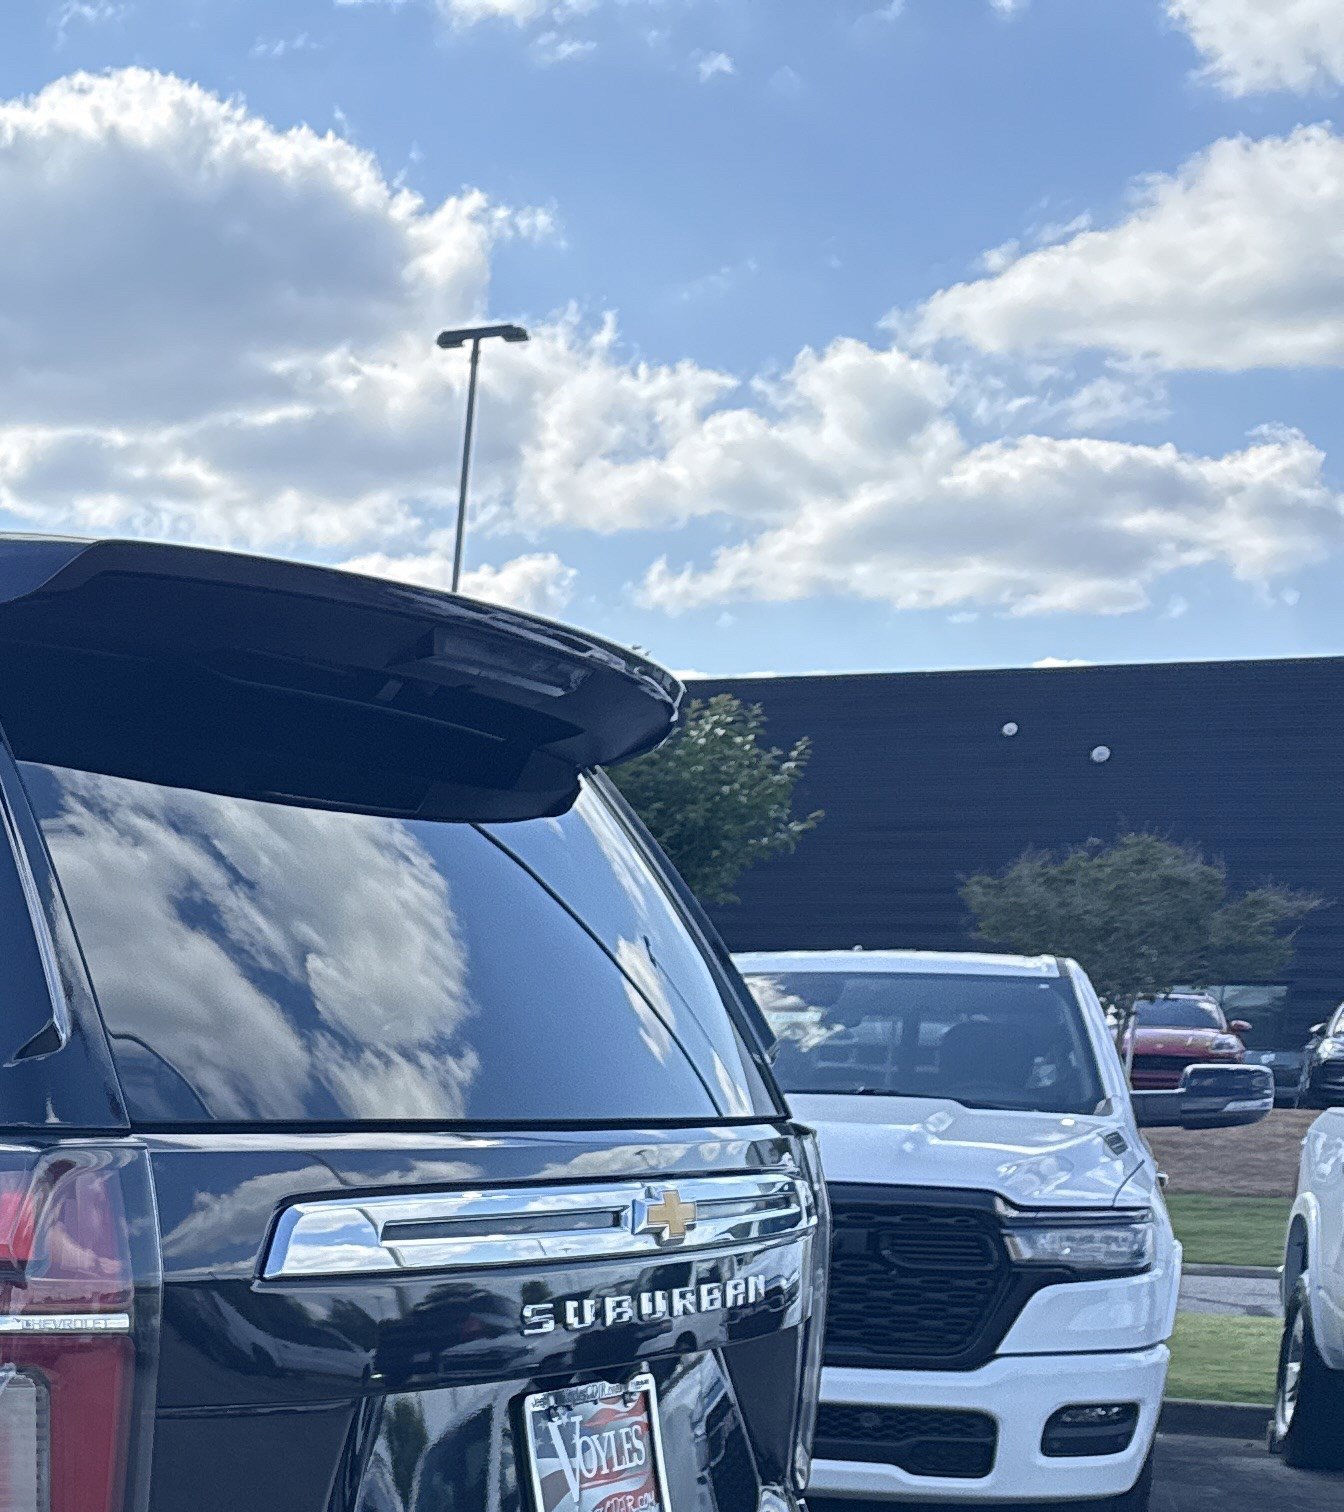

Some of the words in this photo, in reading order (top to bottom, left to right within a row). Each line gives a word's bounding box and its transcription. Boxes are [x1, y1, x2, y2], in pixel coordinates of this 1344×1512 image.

[21, 1317, 108, 1329] CHEVROLET
[521, 1274, 765, 1337] SUBURBAN
[548, 1415, 646, 1503] VOYLES
